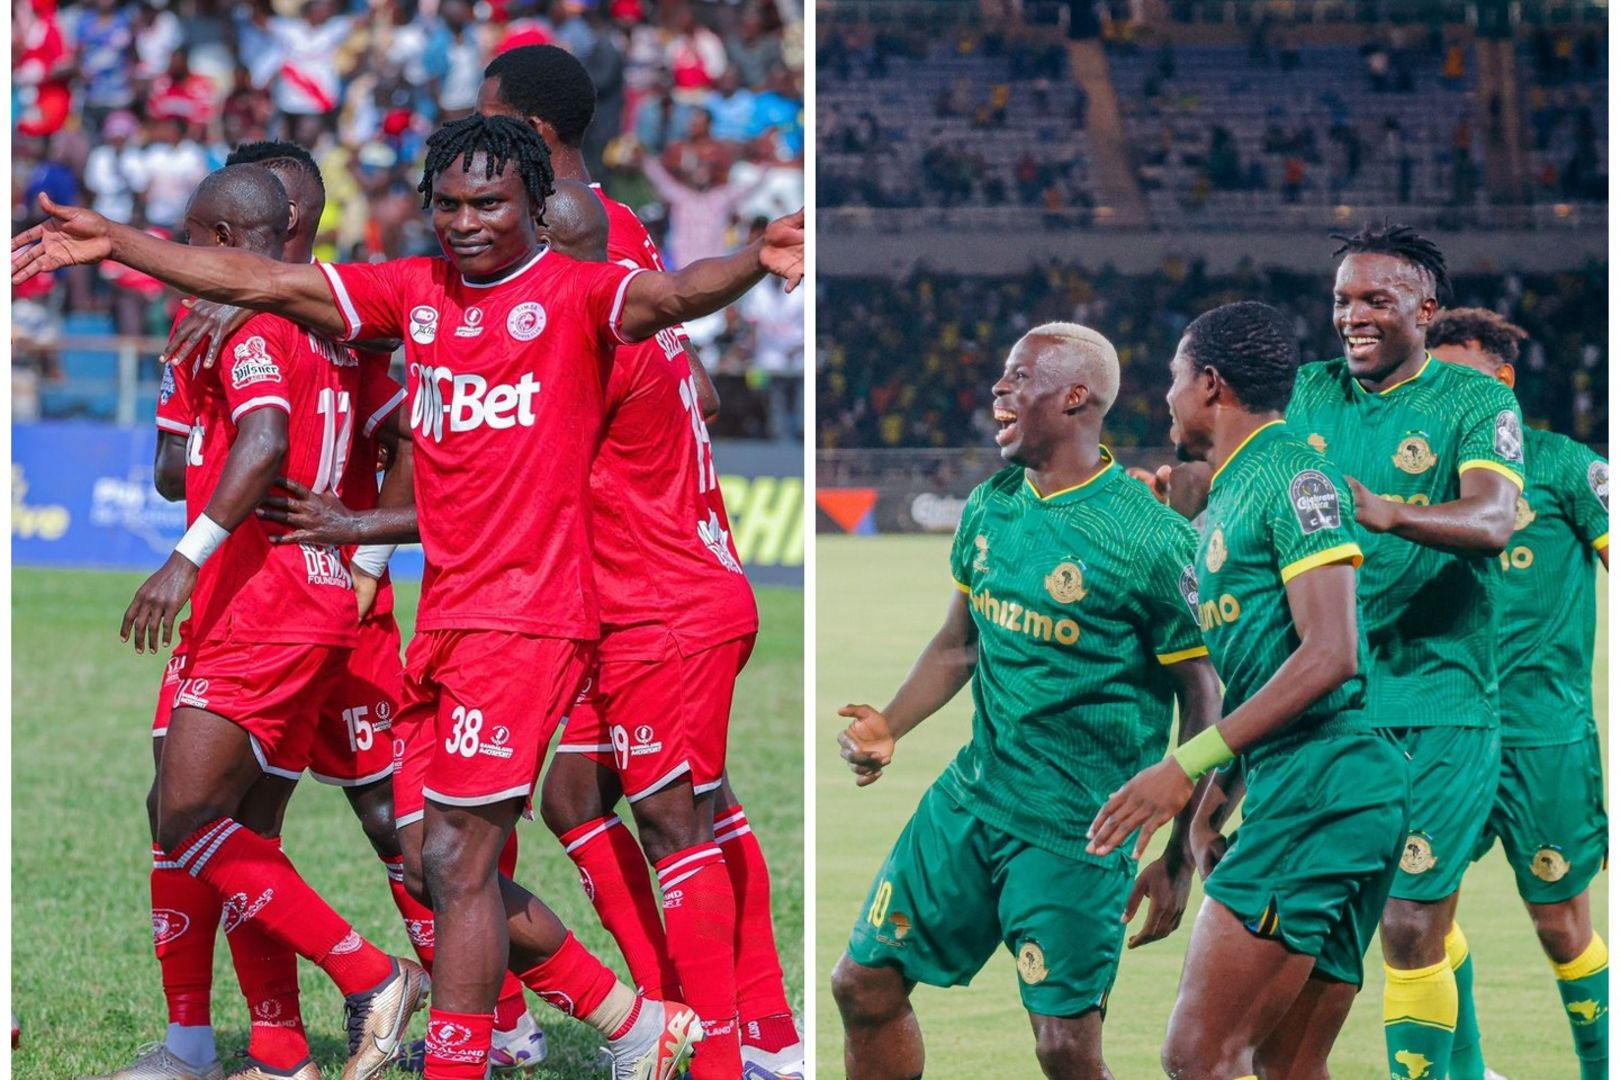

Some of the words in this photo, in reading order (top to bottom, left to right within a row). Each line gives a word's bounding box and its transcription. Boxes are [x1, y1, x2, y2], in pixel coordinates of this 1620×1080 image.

[233, 364, 278, 382] Pilsner
[969, 588, 1080, 645] whizmo
[342, 705, 374, 752] 15
[445, 705, 483, 758] 38
